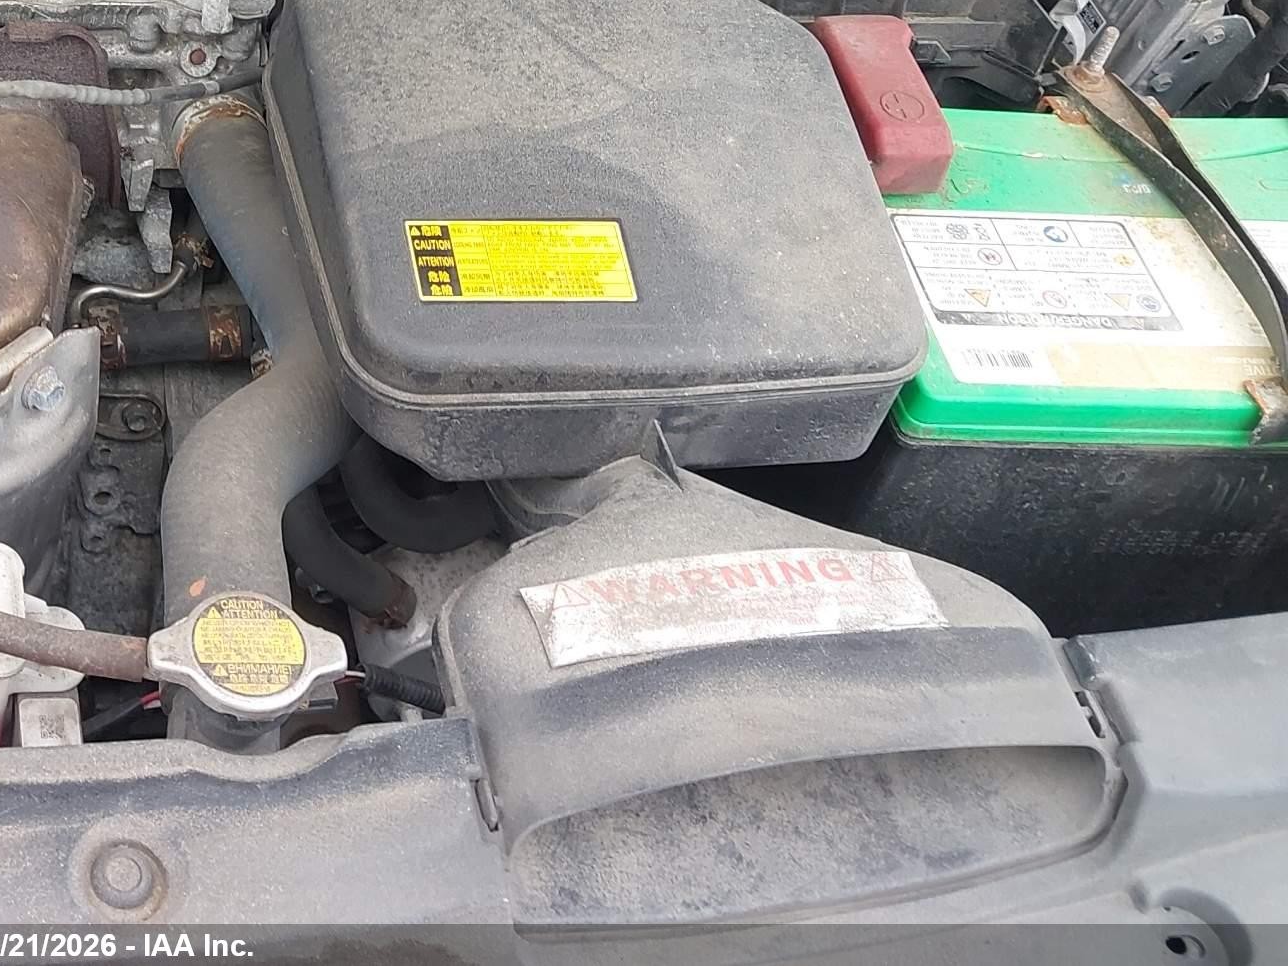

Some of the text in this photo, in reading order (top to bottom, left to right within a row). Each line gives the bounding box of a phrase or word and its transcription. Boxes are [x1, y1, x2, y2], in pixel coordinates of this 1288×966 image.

[414, 239, 451, 251] CAUTION
[418, 256, 455, 267] ATTENTION
[586, 558, 854, 604] WARNING
[220, 599, 264, 610] CAUTION
[222, 609, 278, 619] ATTENTION
